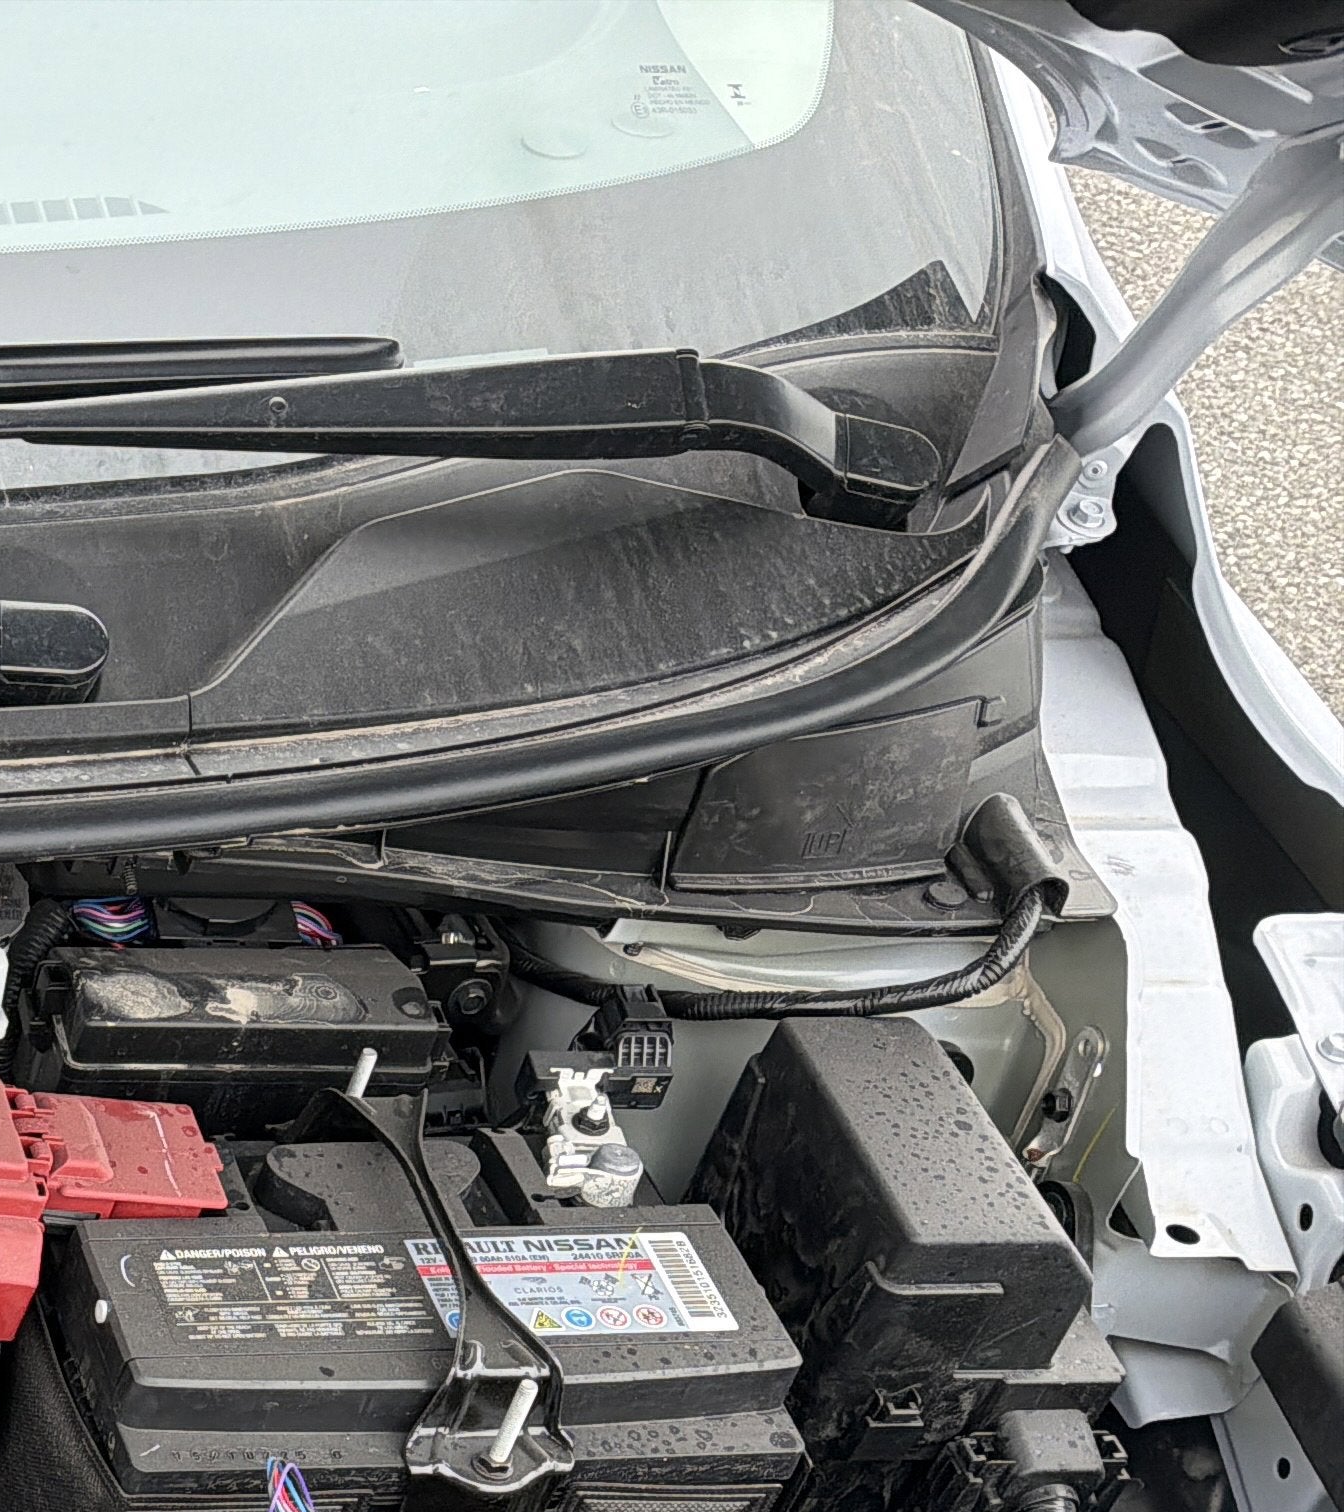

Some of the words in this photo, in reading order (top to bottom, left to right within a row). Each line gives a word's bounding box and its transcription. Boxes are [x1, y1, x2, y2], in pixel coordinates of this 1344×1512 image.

[639, 65, 687, 73] NISSAN
[288, 1244, 385, 1256] PELIGRO/VENENO
[523, 1236, 639, 1252] NISSAN
[175, 1247, 266, 1259] DANGER/POISON
[514, 1285, 564, 1294] CLARIOS
